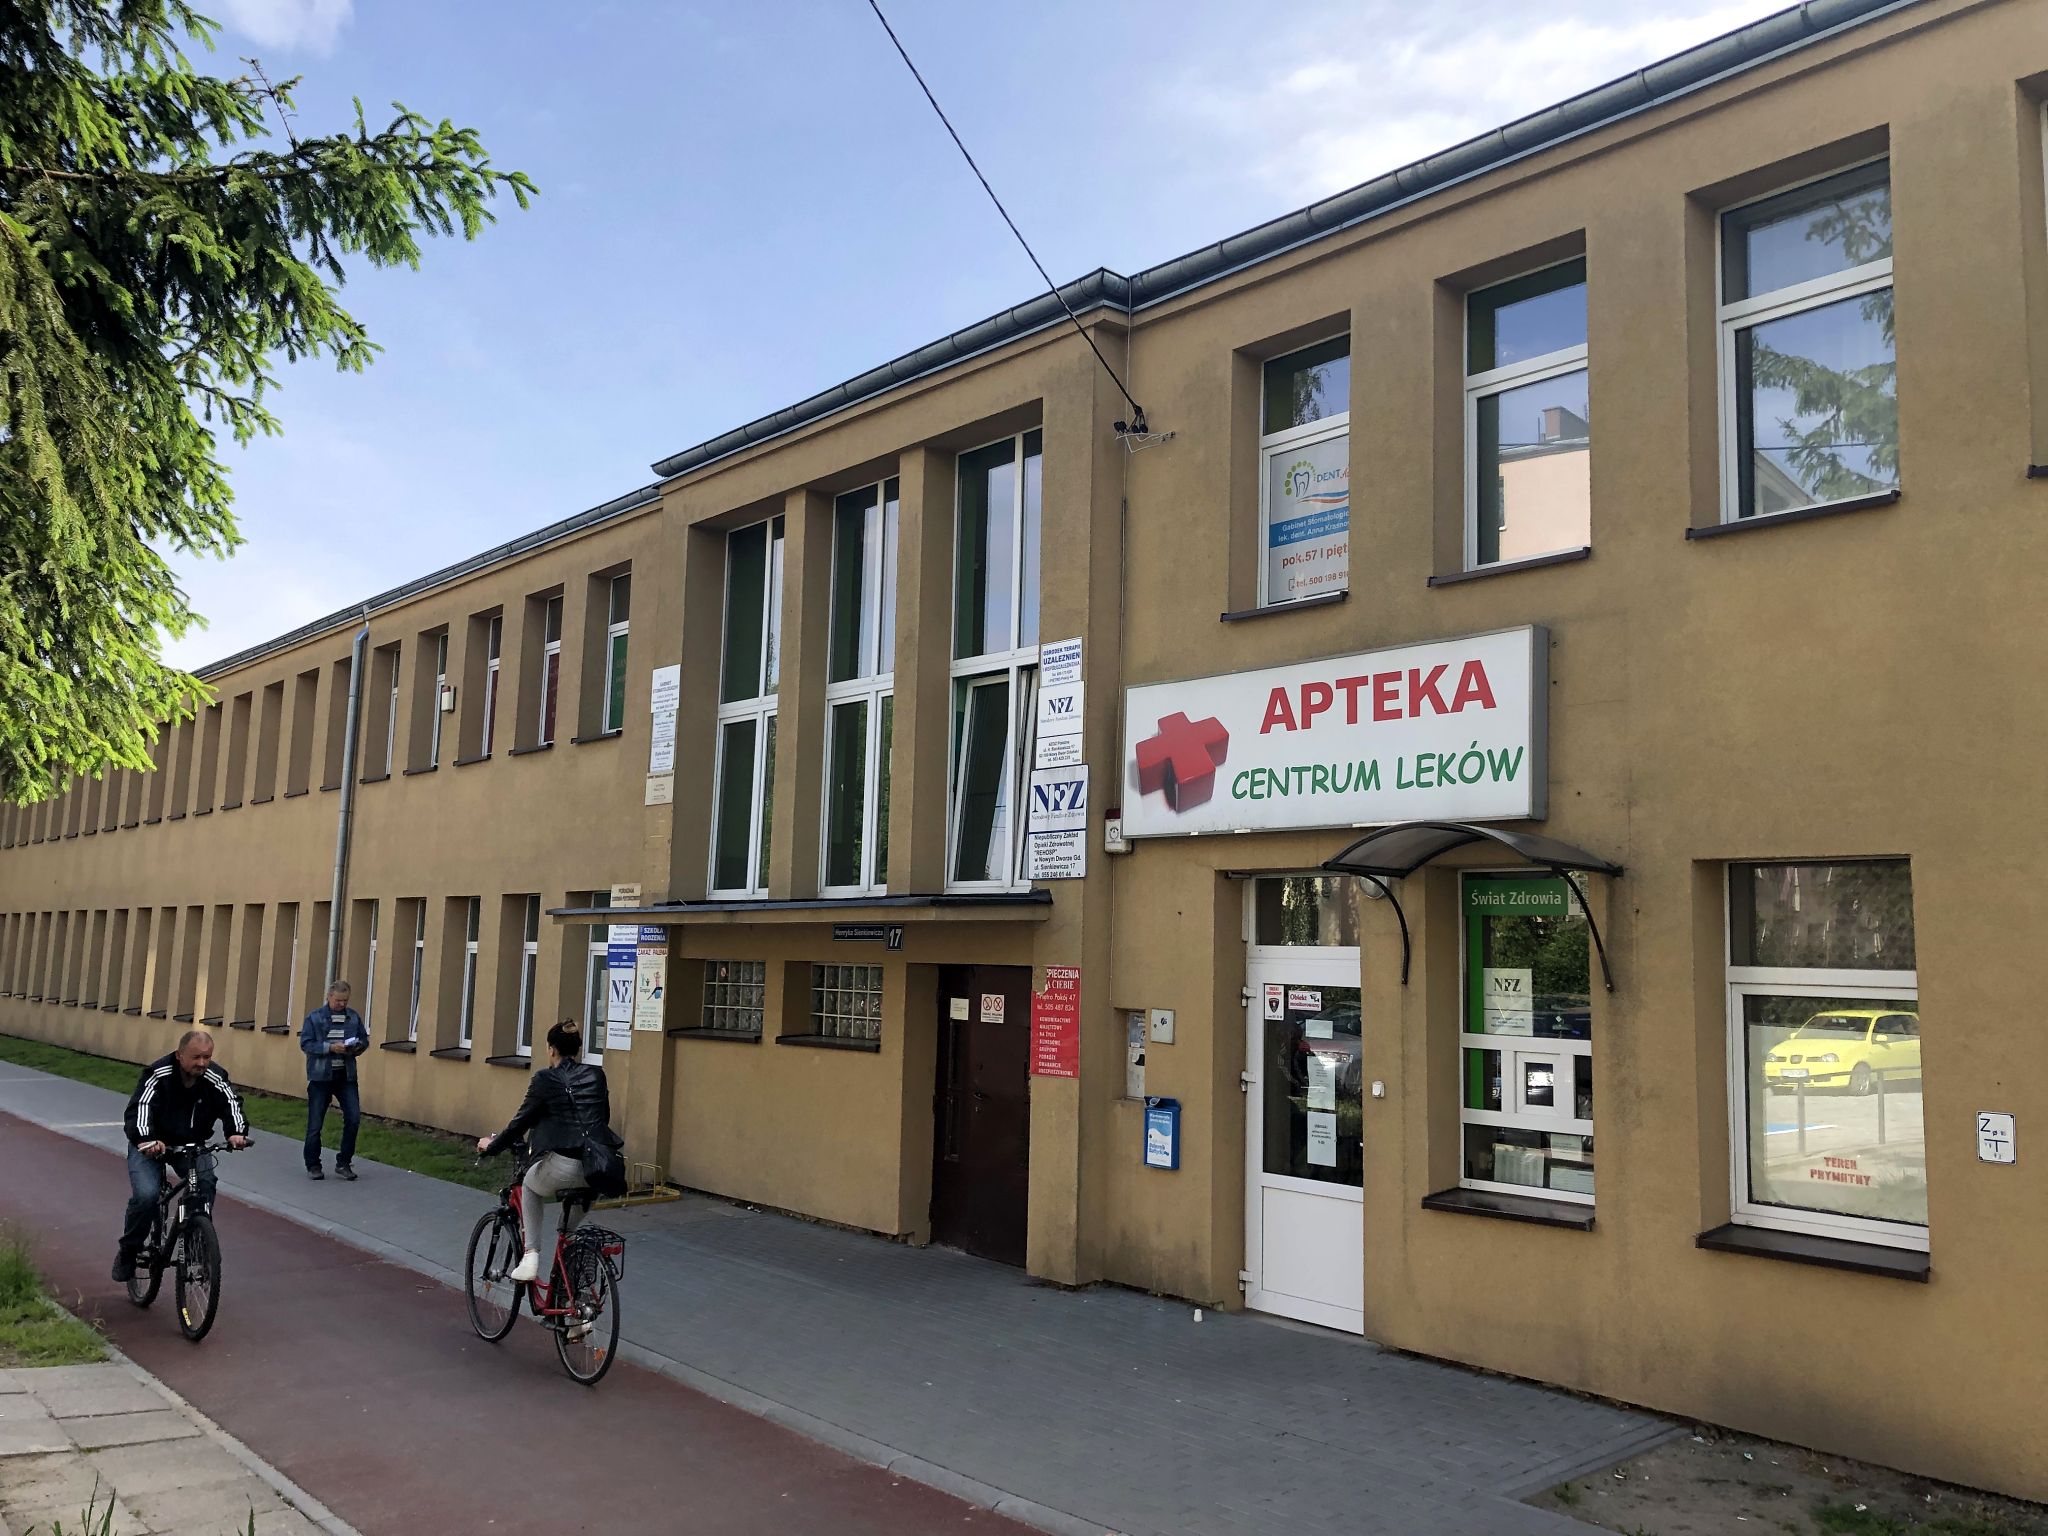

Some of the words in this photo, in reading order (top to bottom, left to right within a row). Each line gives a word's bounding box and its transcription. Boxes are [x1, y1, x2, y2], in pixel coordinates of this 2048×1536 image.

[1282, 520, 1307, 532] Gabinet
[1307, 527, 1324, 535] Anna
[1325, 520, 1350, 531] Krasno
[1309, 576, 1323, 585] 500
[1324, 573, 1337, 582] 198
[1259, 659, 1497, 735] APTEKA
[1048, 696, 1073, 715] NFZ
[1231, 758, 1382, 800] CENTRUM
[1396, 740, 1524, 790] LEKÓW
[1032, 780, 1085, 813] NFZ
[1034, 833, 1062, 841] Niepubliczny
[1471, 889, 1506, 906] Świat
[1509, 891, 1562, 905] Zdrowia
[889, 928, 902, 947] 17
[1052, 980, 1075, 989] CIEBIE
[1494, 978, 1521, 992] NFZ
[1055, 993, 1068, 1003] Pokój
[1980, 1117, 1991, 1132] Z
[1823, 1156, 1858, 1170] TEREN
[1810, 1168, 1871, 1186] PRYWATNY
